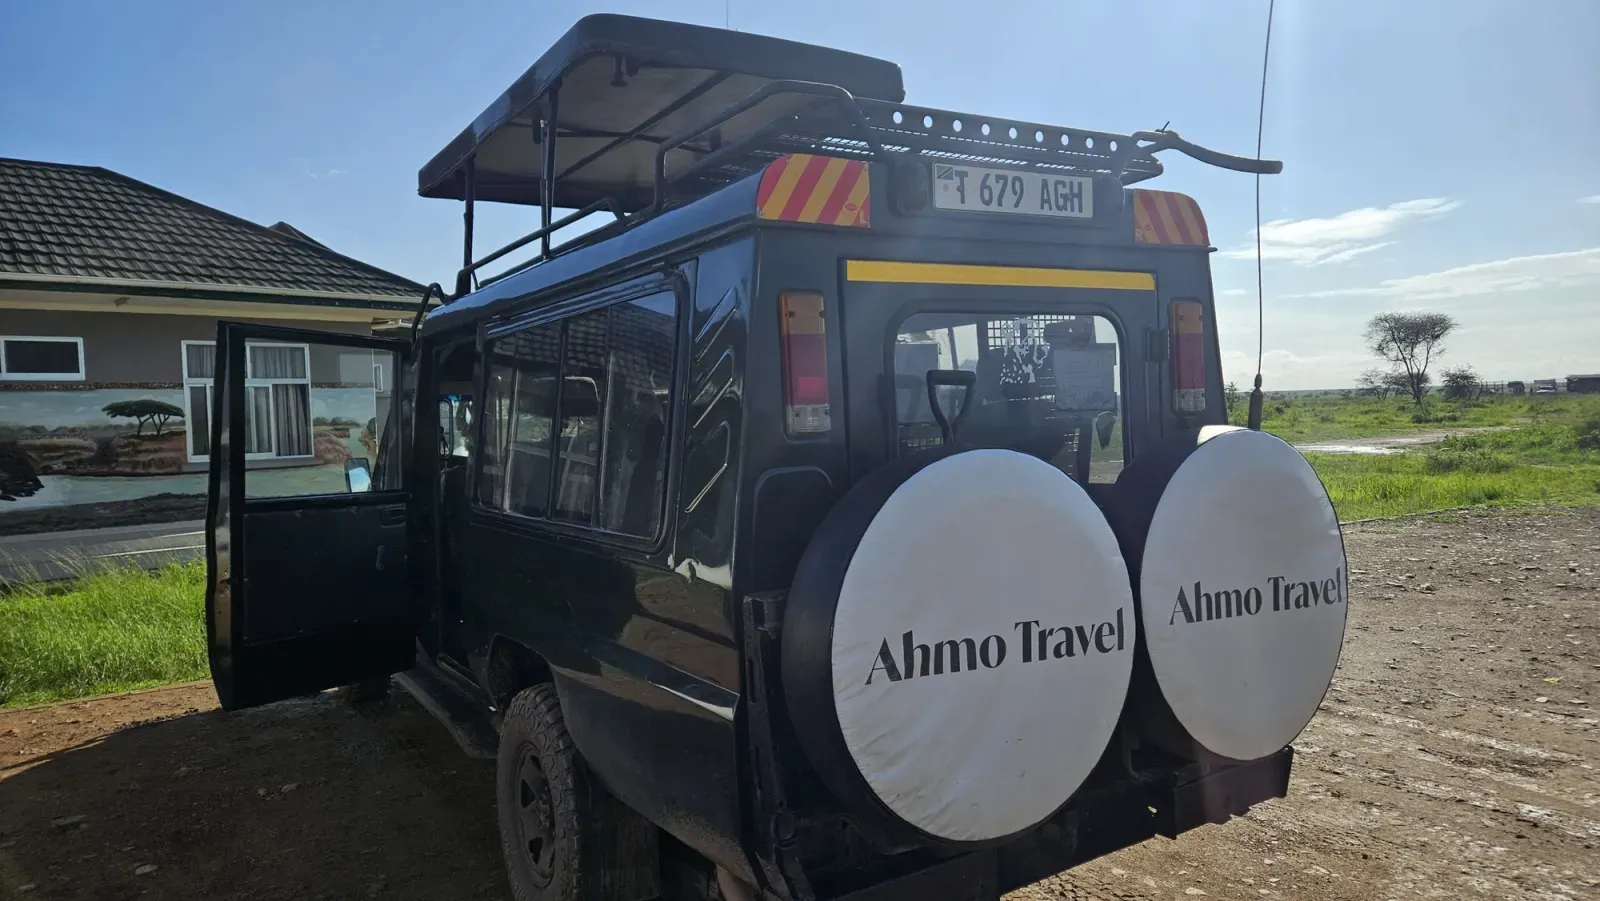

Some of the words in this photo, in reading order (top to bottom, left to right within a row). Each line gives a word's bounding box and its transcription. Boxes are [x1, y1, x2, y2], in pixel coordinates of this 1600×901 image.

[954, 171, 969, 204] T
[979, 173, 1025, 208] 679
[1040, 178, 1083, 213] AGH
[1168, 580, 1263, 626] Ahmo
[1267, 565, 1343, 612] Travel
[864, 629, 1007, 685] Ahmo
[1013, 606, 1125, 663] Travel
